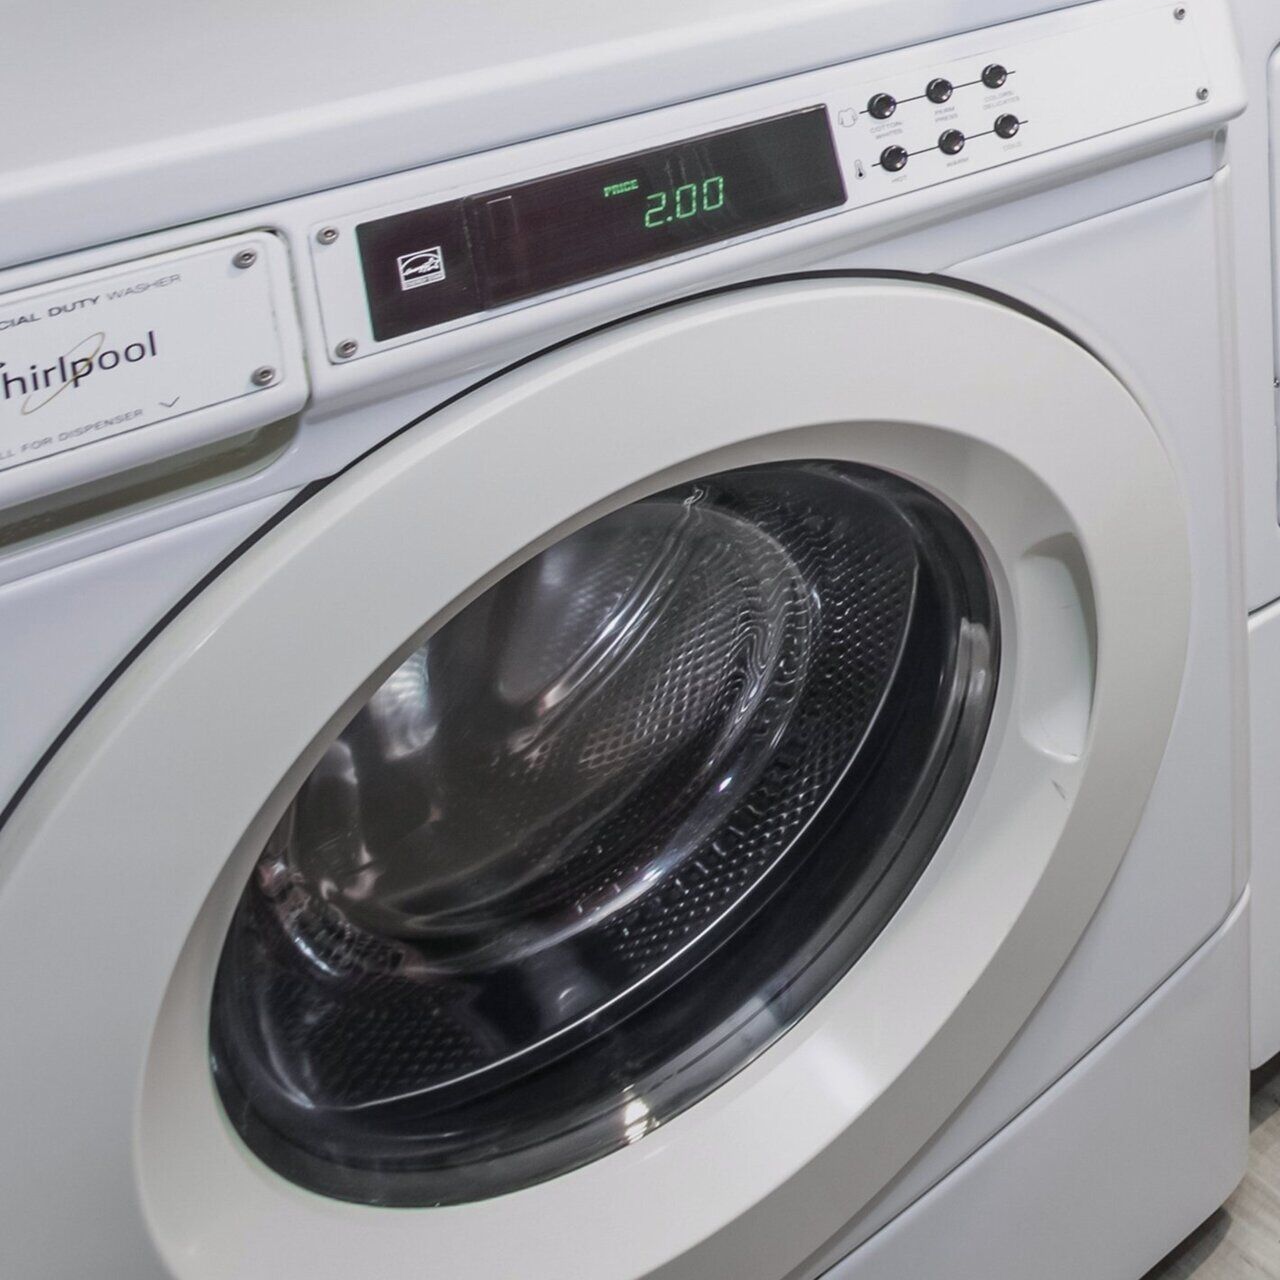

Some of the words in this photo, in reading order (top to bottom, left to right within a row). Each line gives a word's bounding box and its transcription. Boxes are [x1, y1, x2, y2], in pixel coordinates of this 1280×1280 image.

[604, 178, 640, 198] PRICE
[644, 175, 724, 228] 2.00
[48, 295, 100, 318] DUTY
[106, 273, 182, 301] WASHER
[0, 330, 158, 399] hirlpool
[20, 436, 53, 452] FOR
[58, 408, 143, 442] DISPENSER
